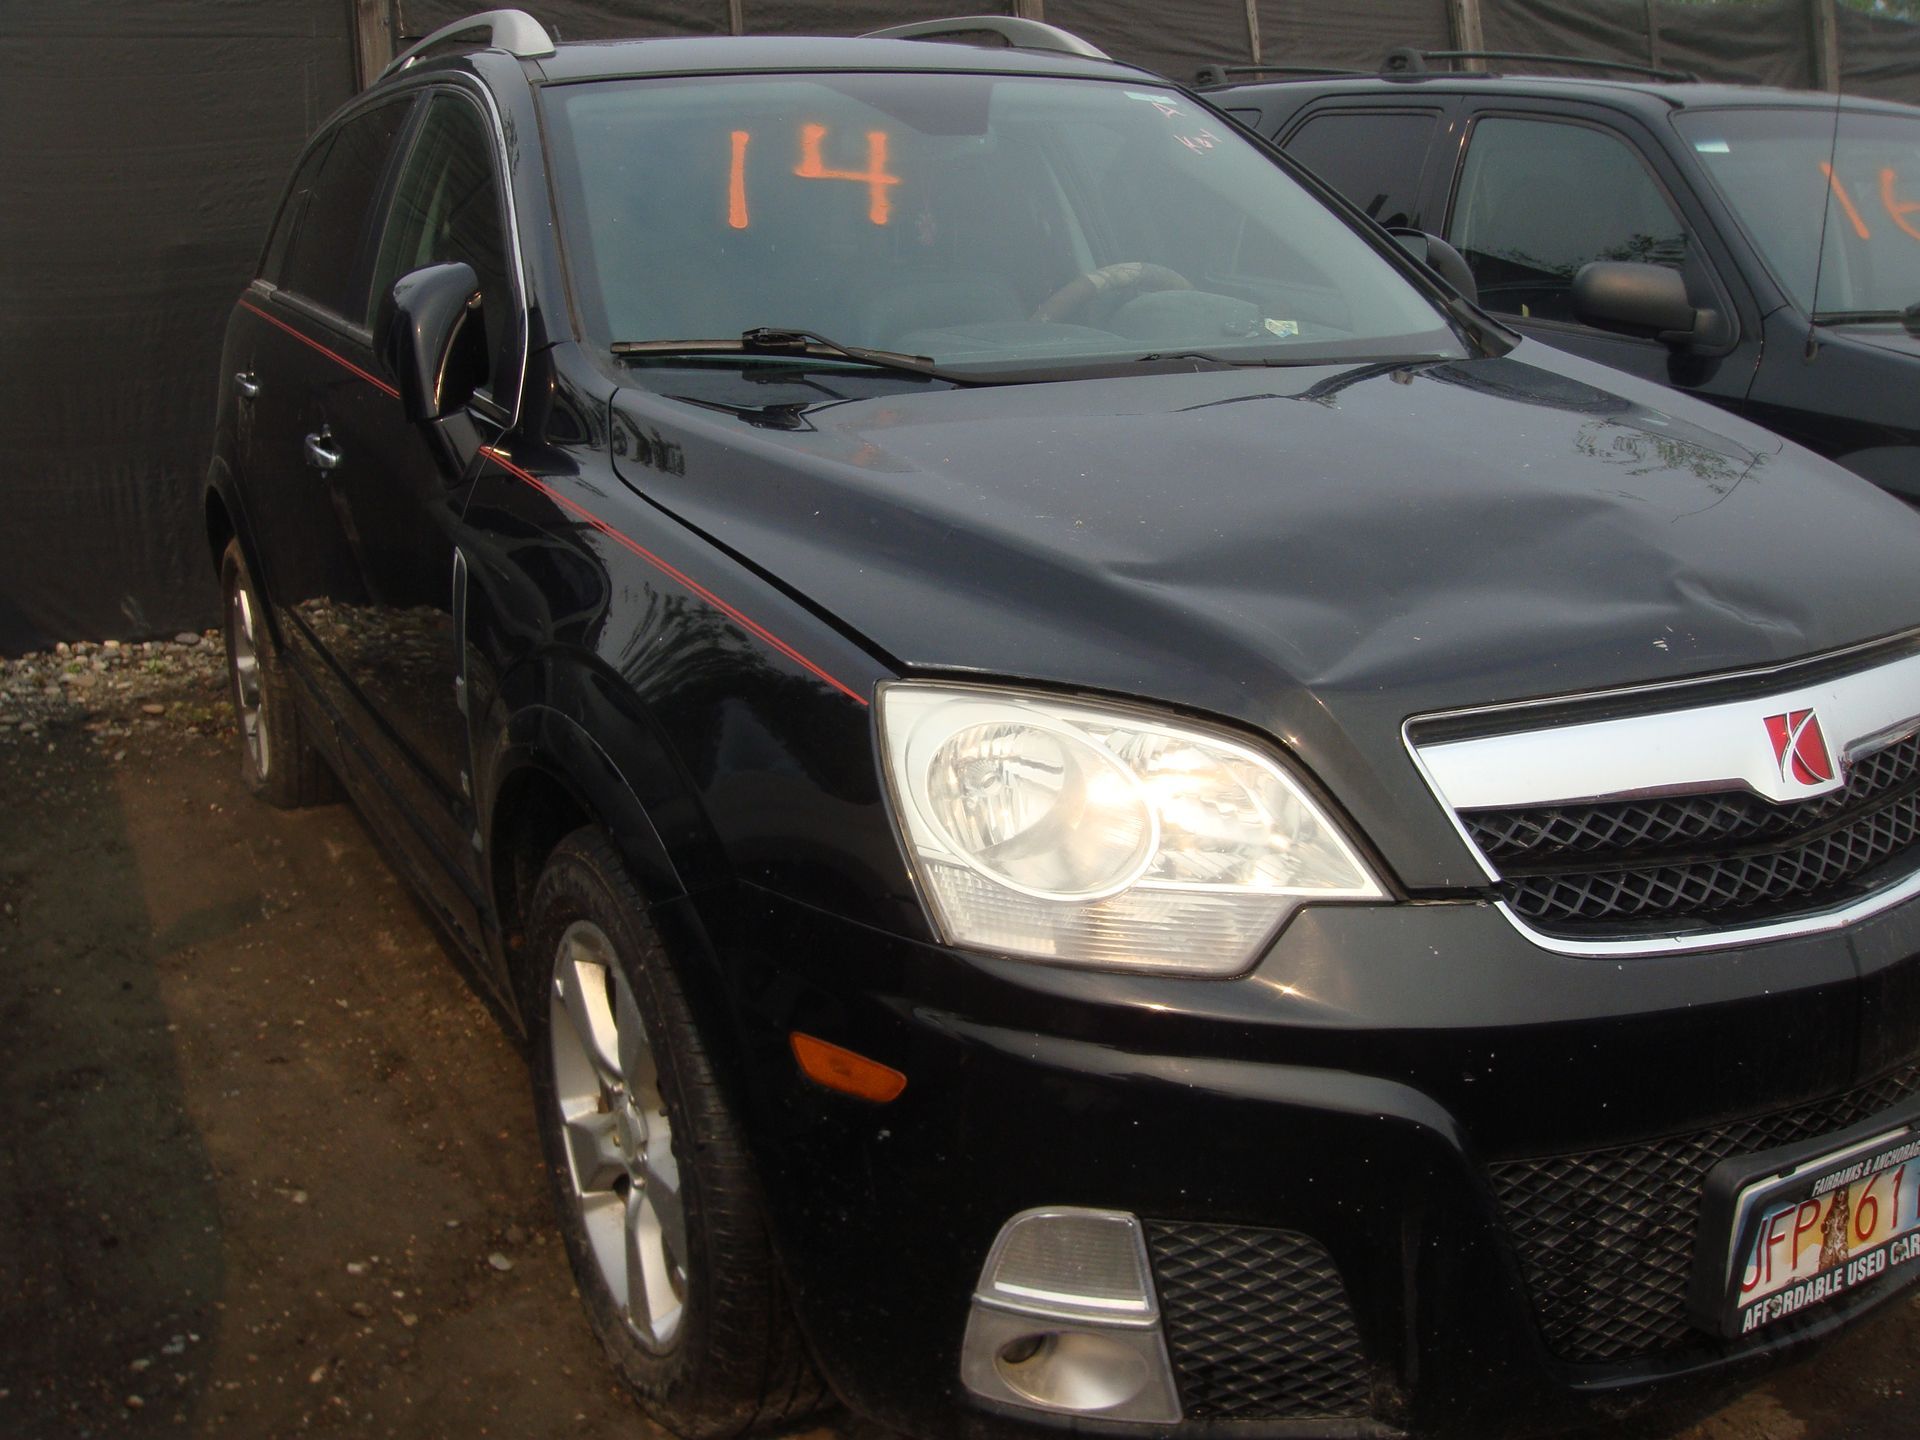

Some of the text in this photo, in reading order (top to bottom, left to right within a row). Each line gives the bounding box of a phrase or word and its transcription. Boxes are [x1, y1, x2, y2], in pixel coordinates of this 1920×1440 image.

[728, 121, 901, 230] 14
[1811, 1161, 1864, 1197] FAIRBANKS
[1863, 1158, 1873, 1176] &
[1740, 1164, 1920, 1293] JFP 61
[1742, 1267, 1844, 1334] AFFORDABLE
[1847, 1249, 1886, 1287] USED
